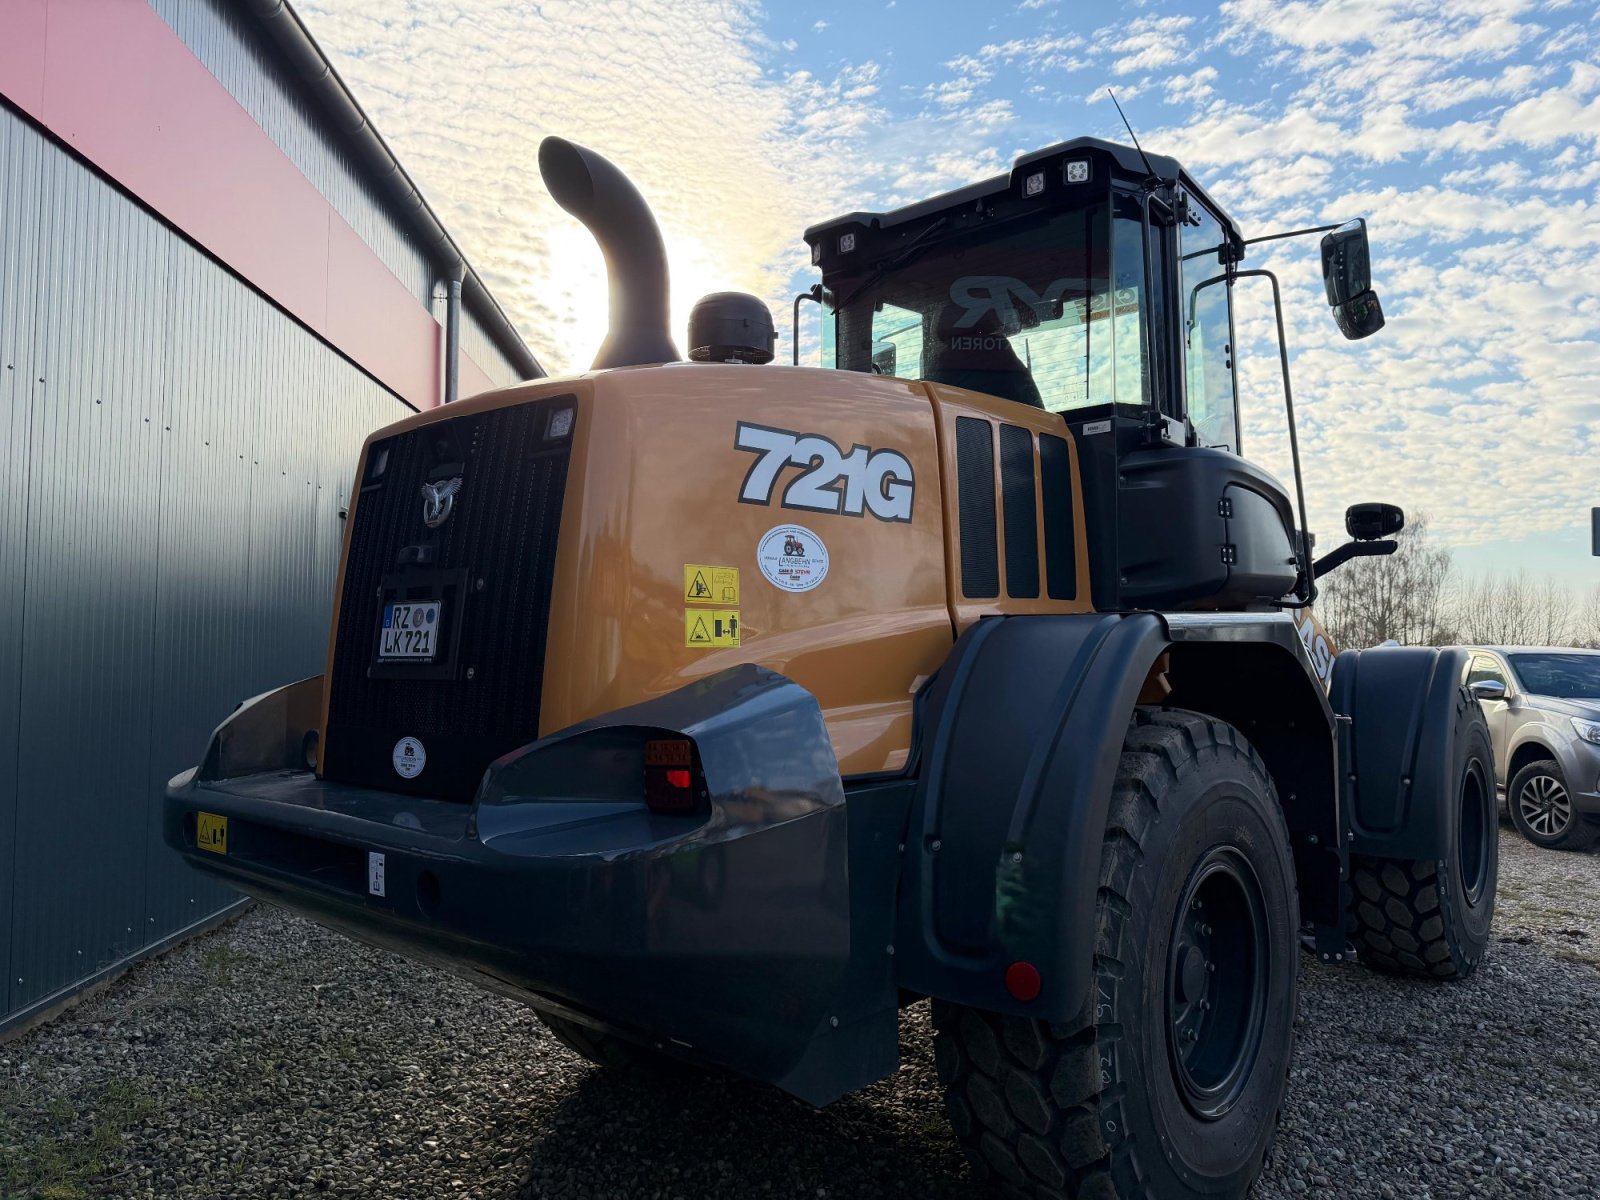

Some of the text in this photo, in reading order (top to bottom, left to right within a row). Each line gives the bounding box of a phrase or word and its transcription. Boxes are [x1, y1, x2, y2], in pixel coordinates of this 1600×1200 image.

[734, 420, 915, 524] 721G
[778, 556, 811, 567] LANGBEHN
[393, 606, 411, 629] RZ
[385, 630, 429, 653] LK 721
